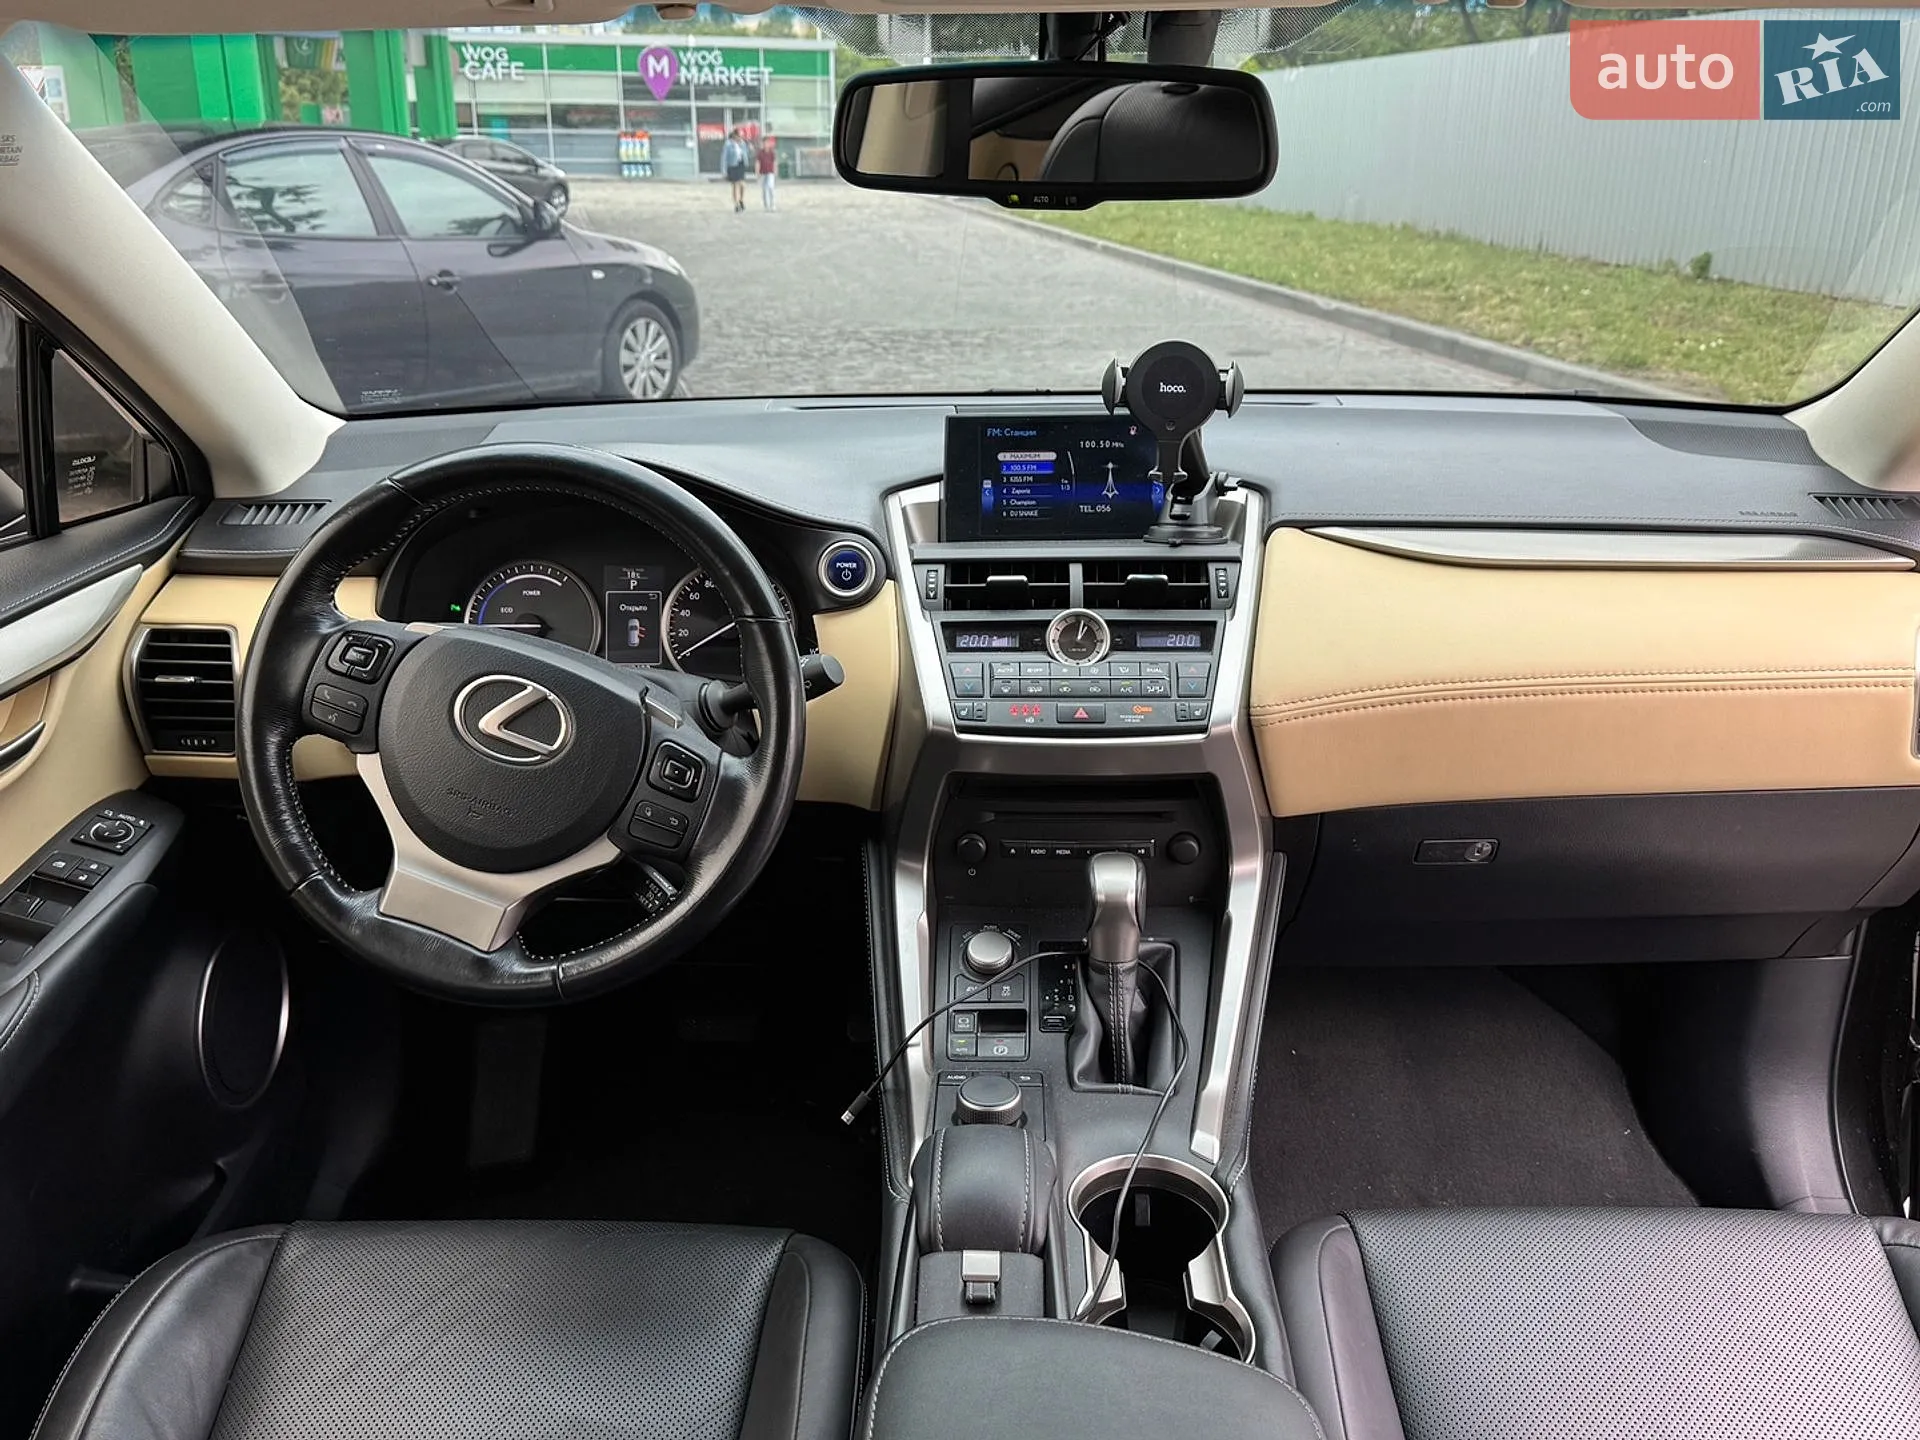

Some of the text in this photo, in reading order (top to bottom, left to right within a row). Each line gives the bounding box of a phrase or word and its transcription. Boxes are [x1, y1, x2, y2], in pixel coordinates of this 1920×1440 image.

[461, 45, 509, 61] WOG
[679, 49, 723, 66] WOG
[464, 61, 525, 81] CAFE
[647, 54, 671, 79] M
[680, 66, 774, 86] MARKET
[630, 580, 638, 590] P
[689, 592, 700, 601] 60
[680, 609, 691, 617] 40
[678, 629, 689, 637] 20
[1167, 634, 1196, 647] 20.0
